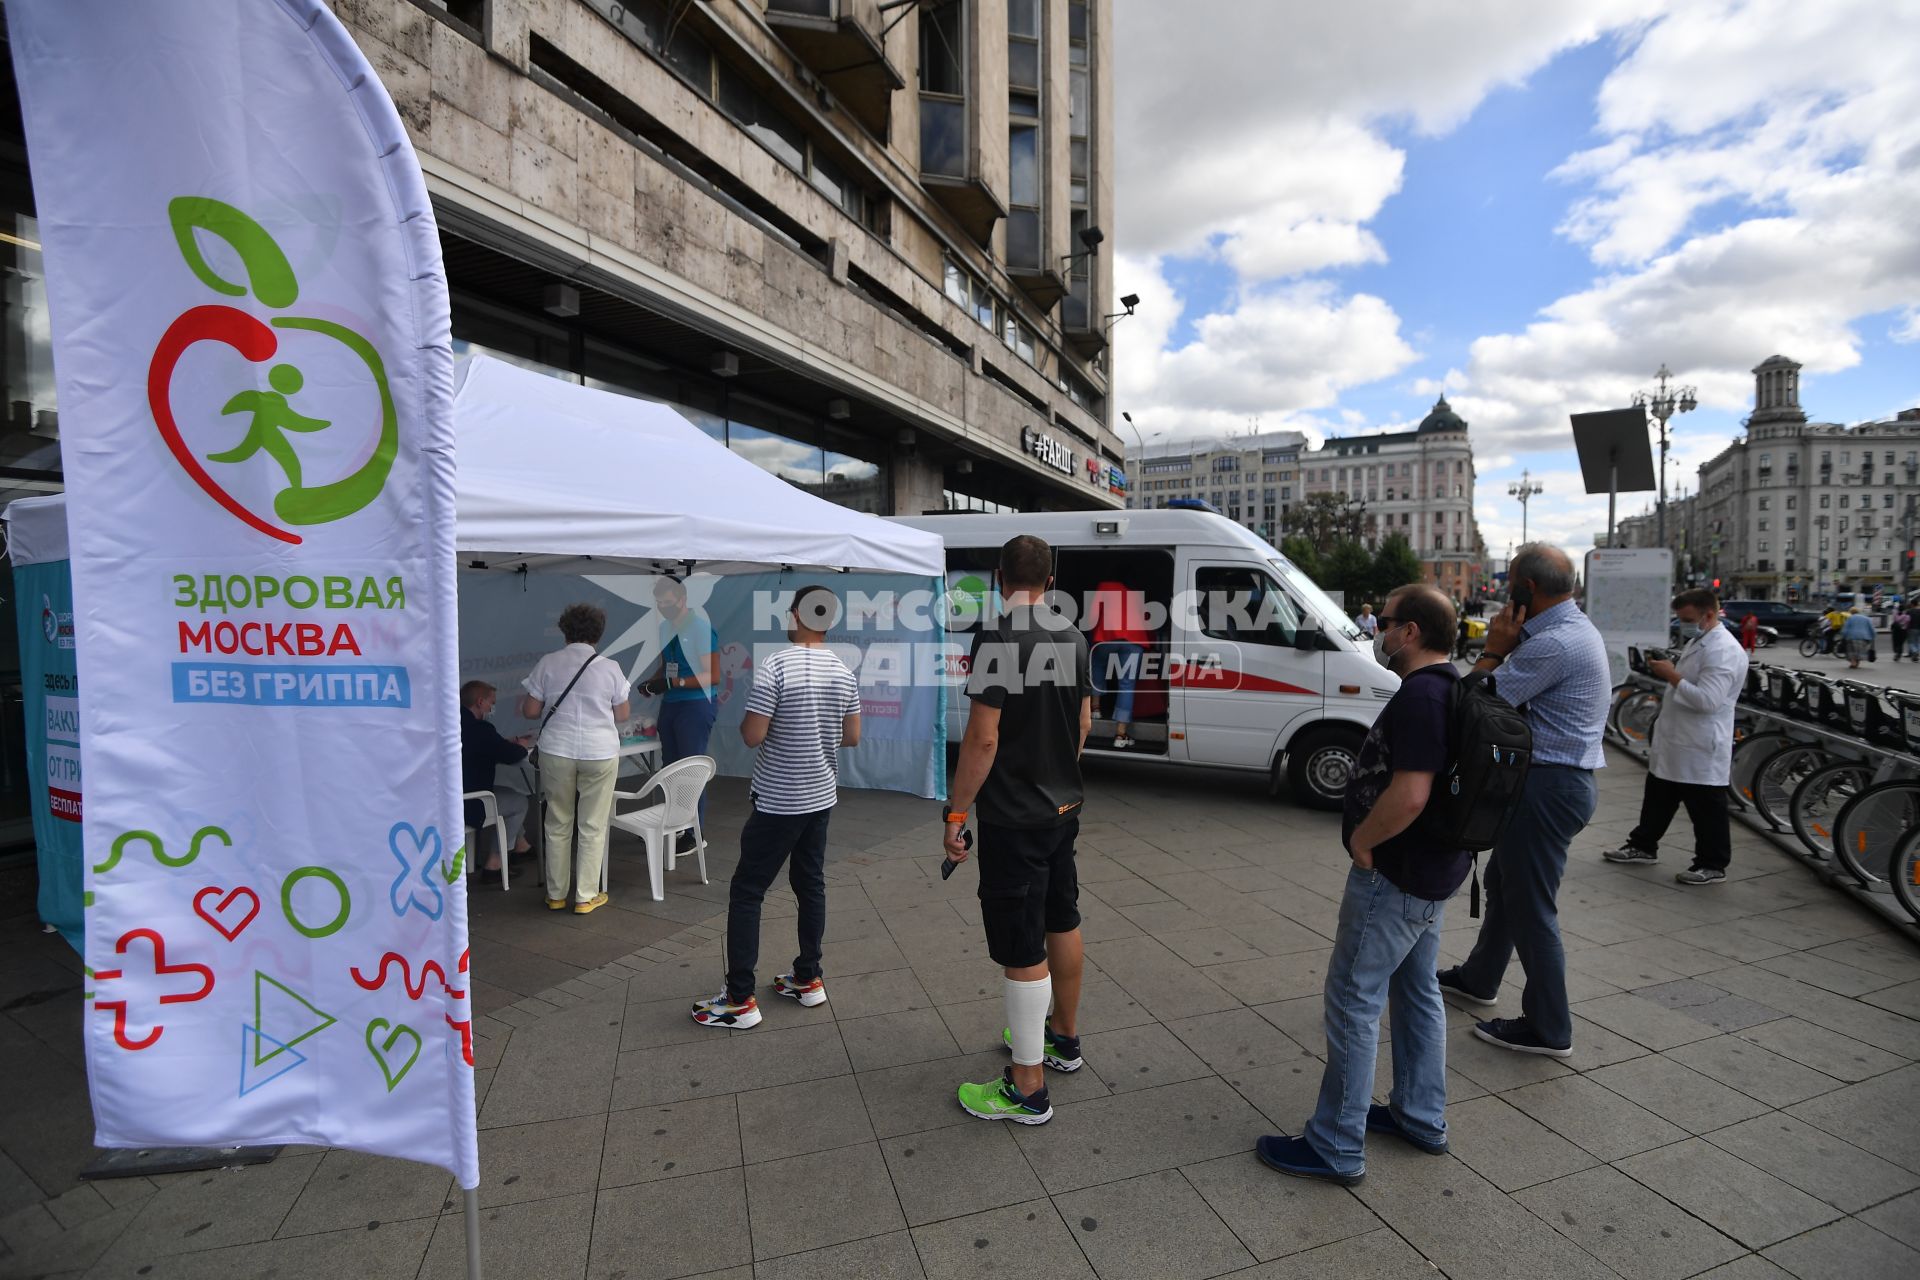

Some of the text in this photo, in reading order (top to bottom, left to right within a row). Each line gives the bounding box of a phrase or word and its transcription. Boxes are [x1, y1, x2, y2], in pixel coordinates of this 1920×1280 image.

[173, 574, 406, 614] ЗДОРОВАЯ
[178, 621, 362, 656] МОСКВА
[45, 673, 70, 691] здесь
[188, 670, 402, 701] БЕЗ ГРИППА
[50, 756, 61, 777] ОТ
